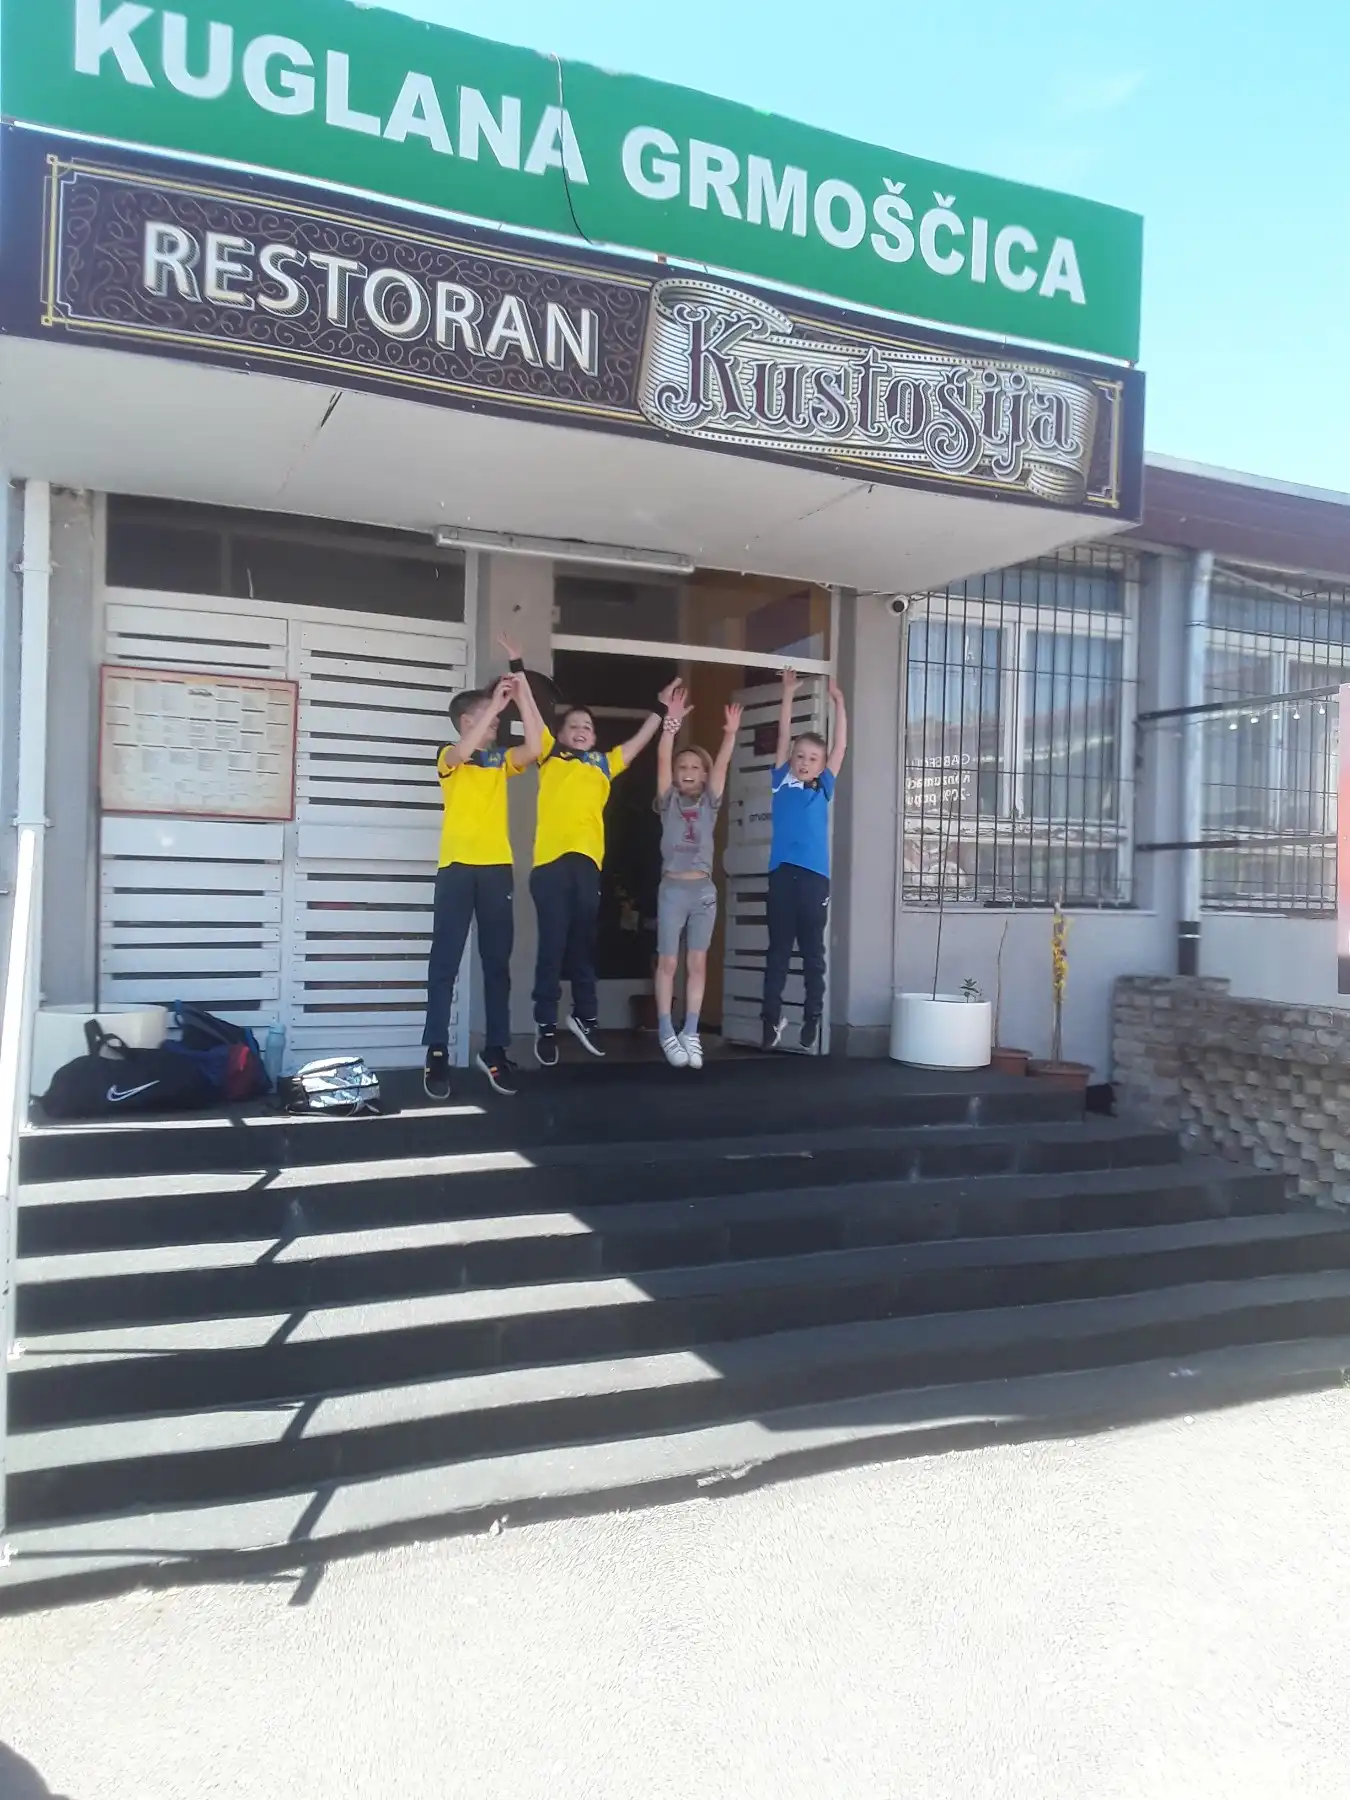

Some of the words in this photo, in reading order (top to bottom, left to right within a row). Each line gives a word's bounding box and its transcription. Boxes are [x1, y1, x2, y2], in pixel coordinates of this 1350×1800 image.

[74, 0, 590, 185] KUGLANA
[621, 126, 1087, 304] GRMOŠČICA
[143, 220, 600, 377] RESTORAN
